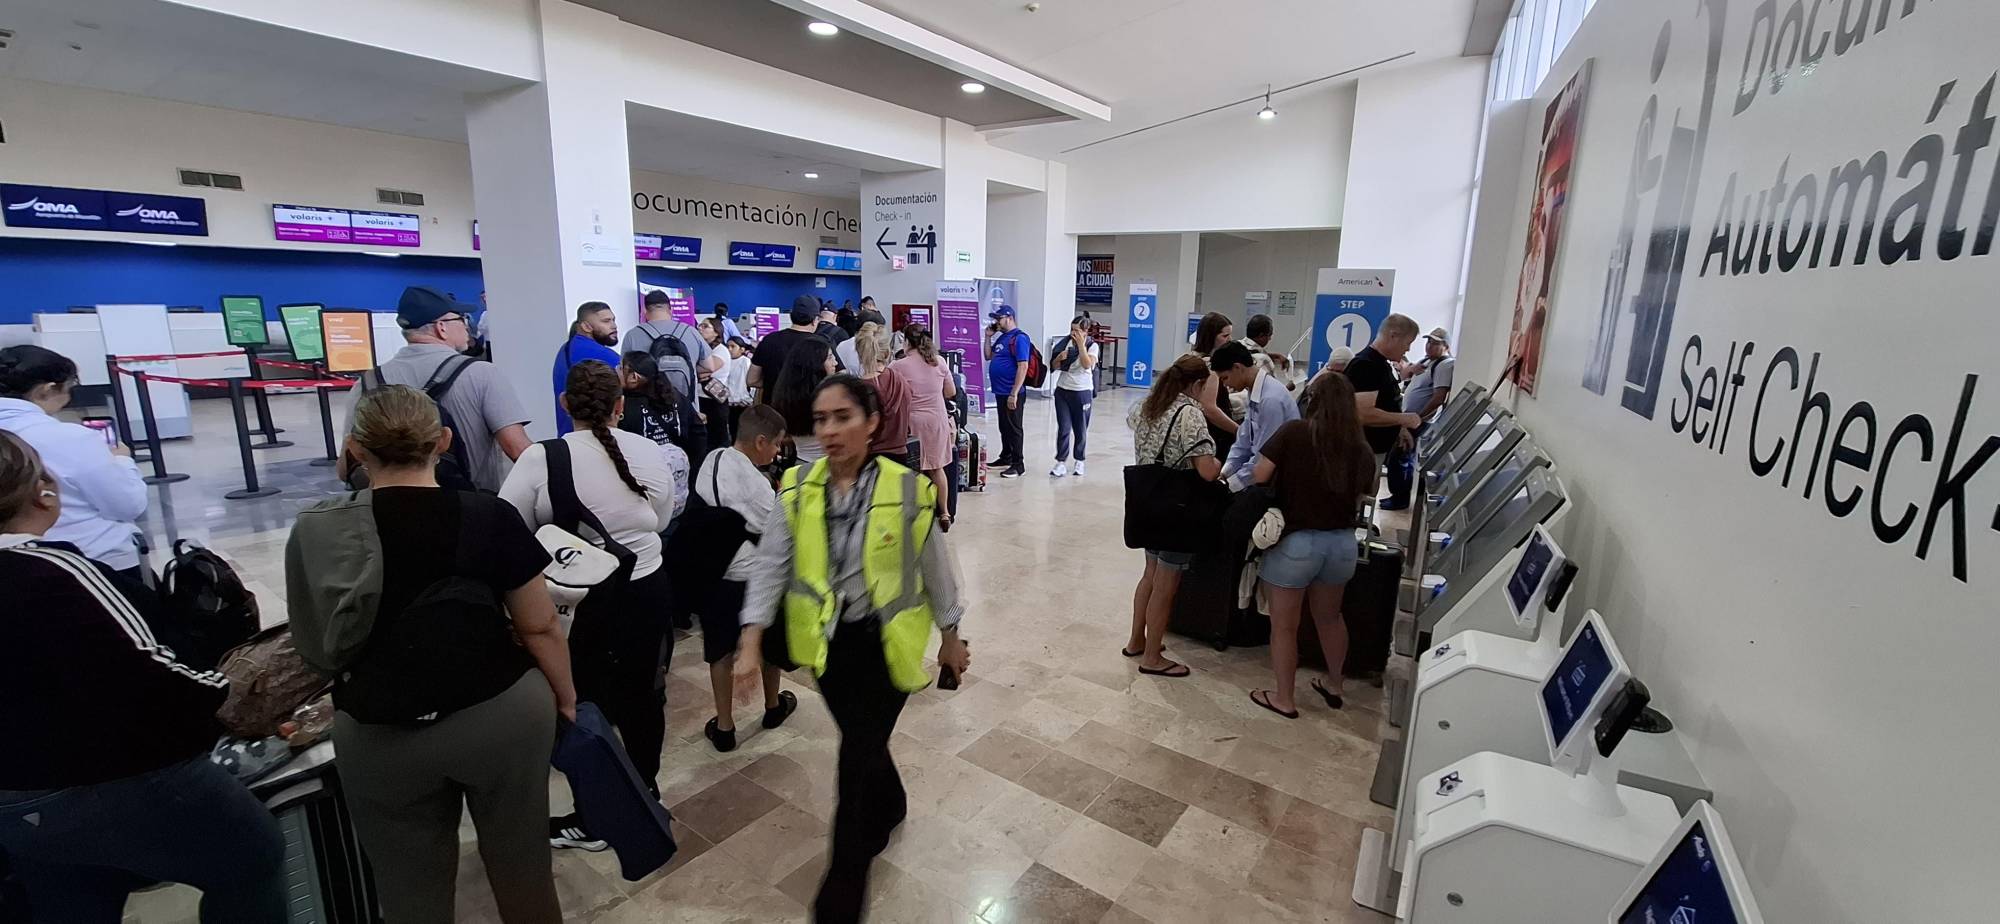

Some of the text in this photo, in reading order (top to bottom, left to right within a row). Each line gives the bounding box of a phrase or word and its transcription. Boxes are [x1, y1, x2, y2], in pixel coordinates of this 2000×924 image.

[875, 192, 937, 206] Documentación
[33, 202, 79, 214] OMA
[633, 192, 807, 228] ocumentación
[823, 209, 861, 233] Che
[138, 209, 179, 220] OMA
[290, 213, 323, 221] volaris
[874, 211, 898, 222] Check
[365, 218, 394, 226] volaris
[1338, 277, 1373, 286] American
[940, 285, 960, 293] volaris
[1340, 300, 1365, 309] STEP
[1138, 305, 1145, 317] 2
[1342, 321, 1354, 348] 1
[1671, 334, 1755, 455] Self
